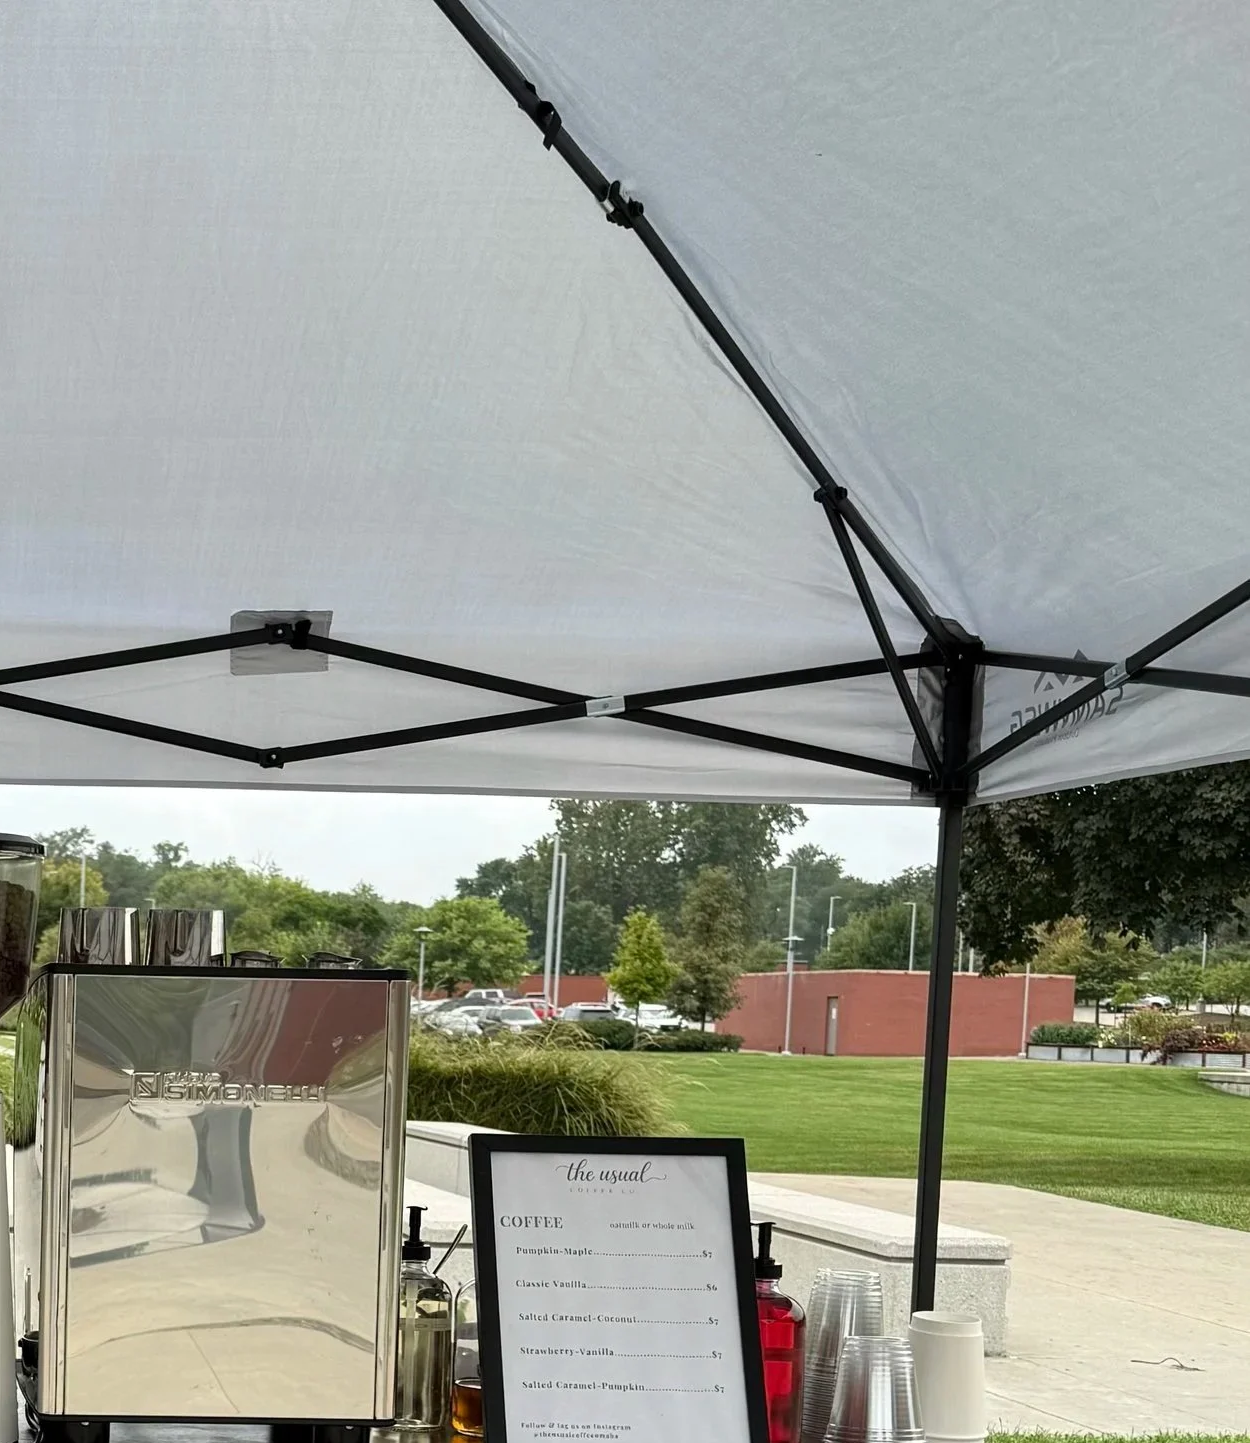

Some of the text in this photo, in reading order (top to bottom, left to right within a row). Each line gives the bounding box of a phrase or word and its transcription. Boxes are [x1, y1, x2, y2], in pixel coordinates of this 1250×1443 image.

[554, 1159, 667, 1184] the usual
[500, 1215, 564, 1229] COFFEE
[515, 1279, 551, 1288] Classic
[518, 1313, 549, 1322] Salted
[522, 1381, 553, 1389] Salted
